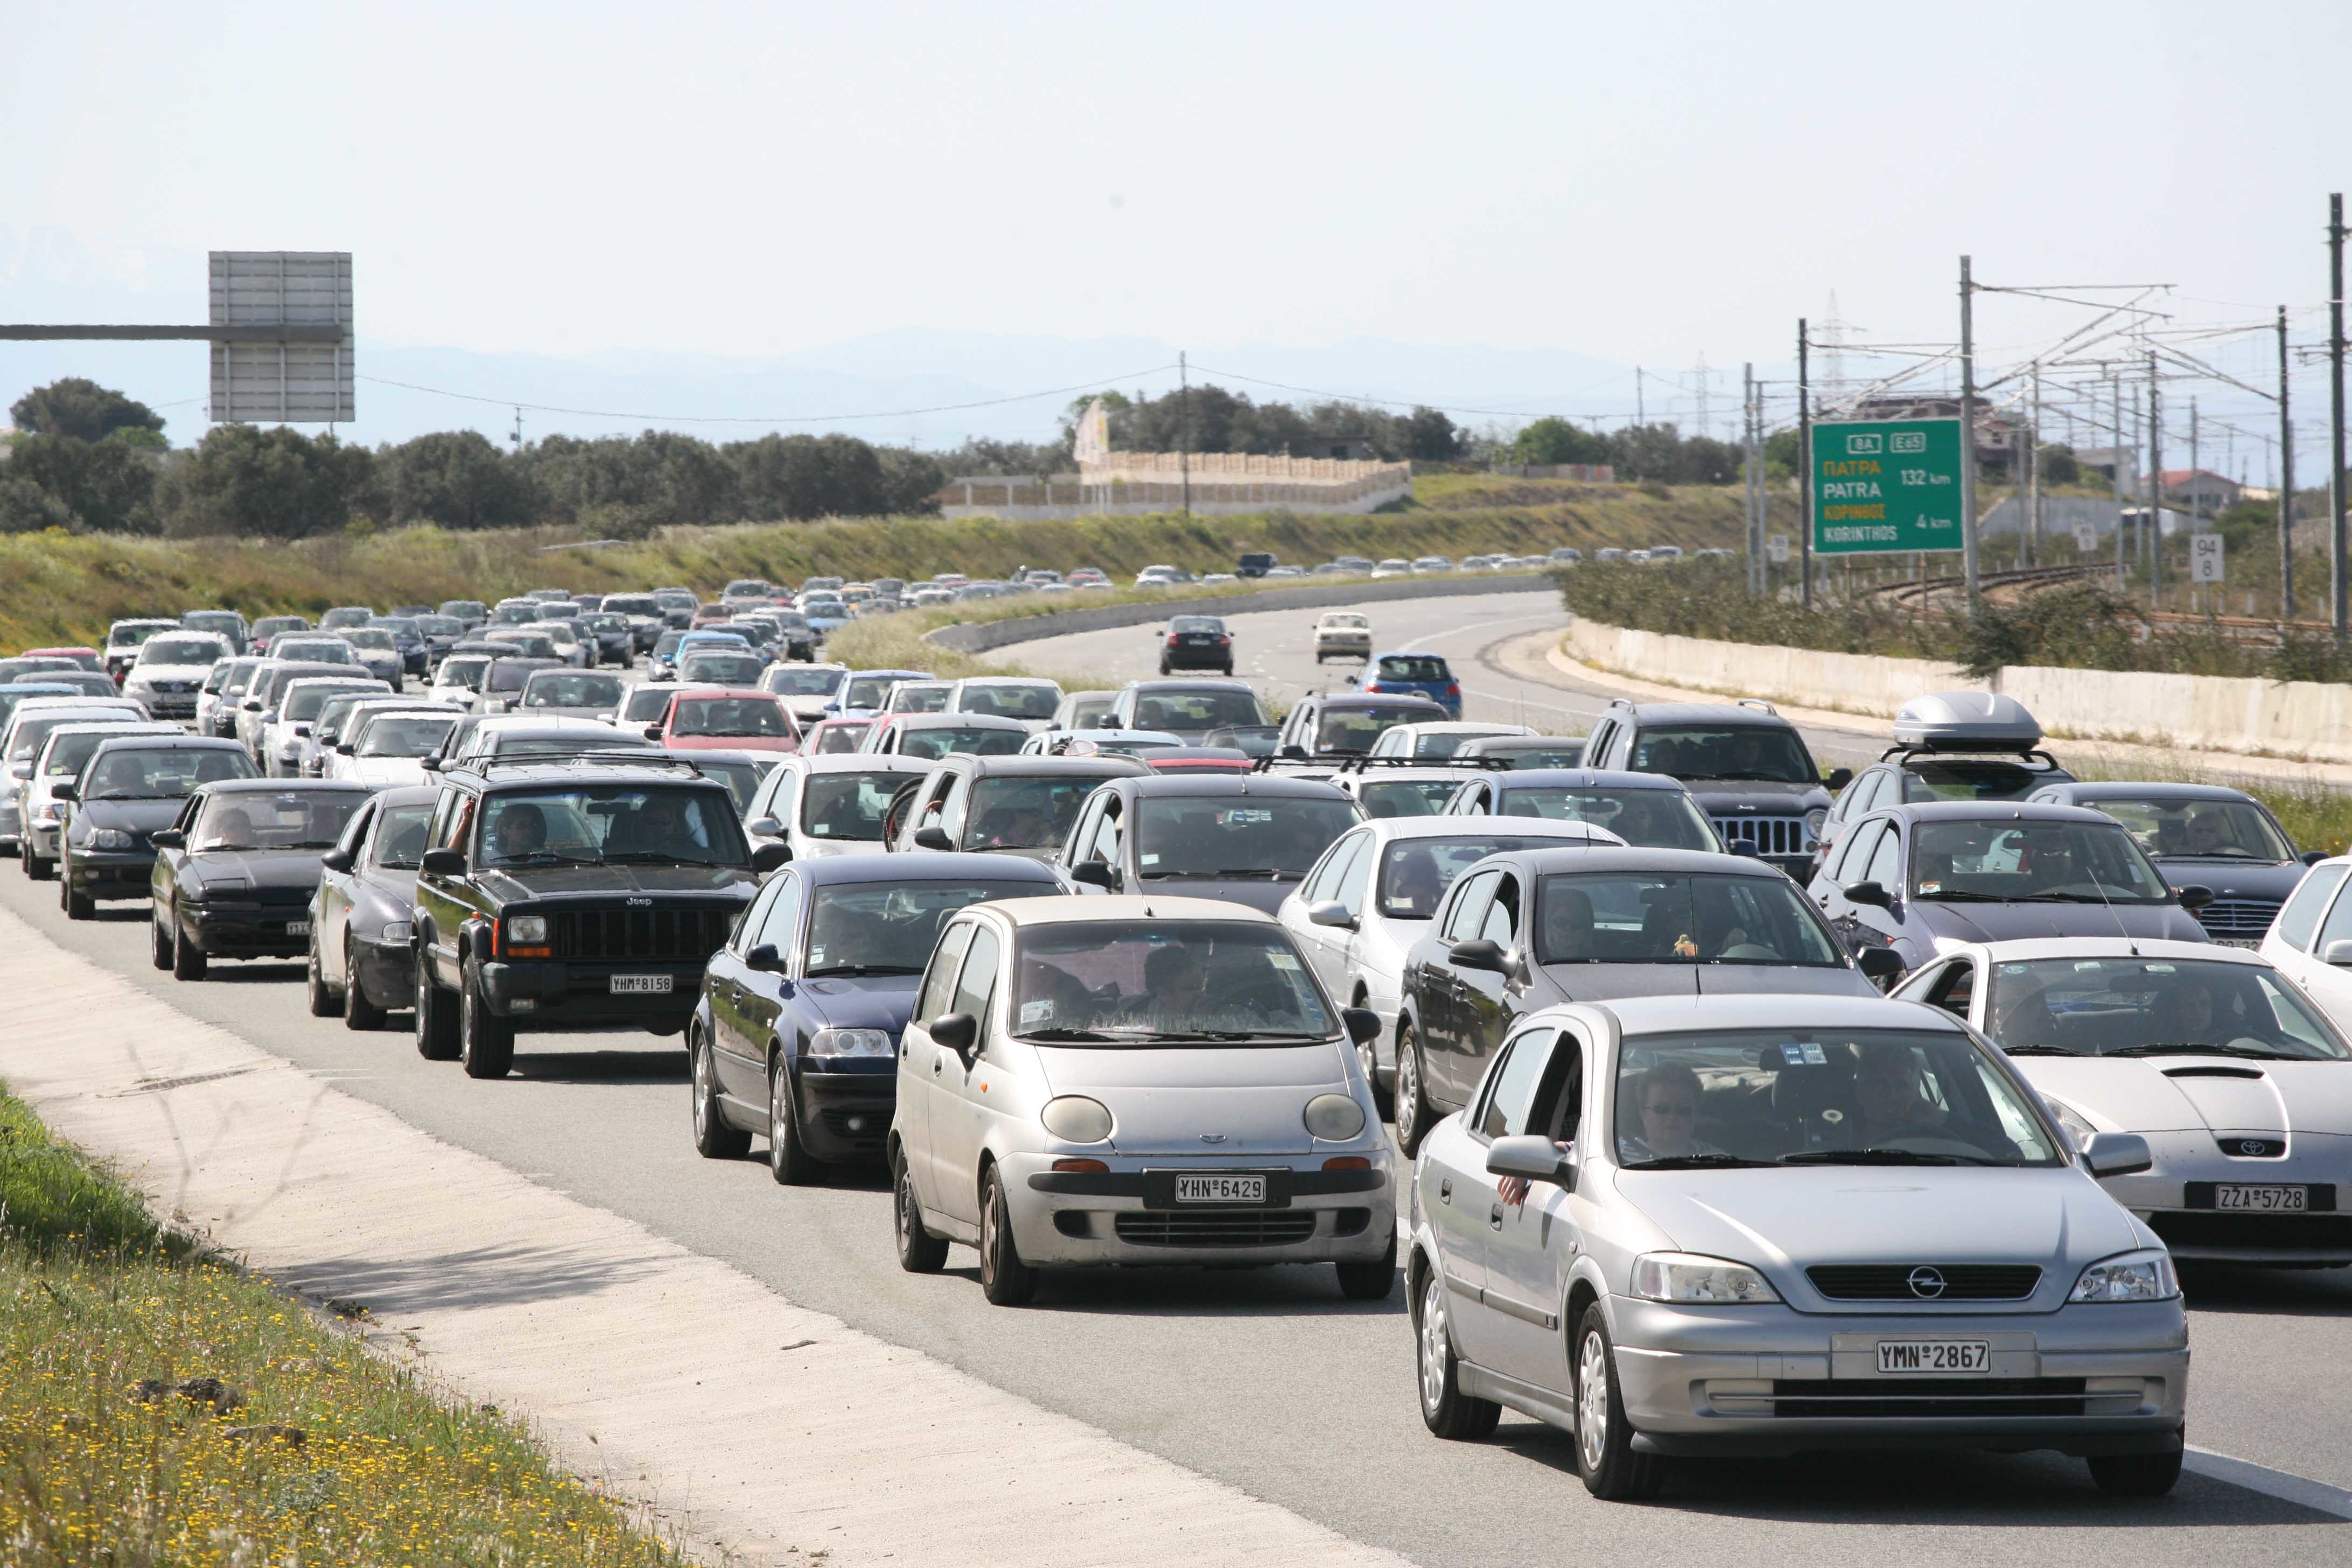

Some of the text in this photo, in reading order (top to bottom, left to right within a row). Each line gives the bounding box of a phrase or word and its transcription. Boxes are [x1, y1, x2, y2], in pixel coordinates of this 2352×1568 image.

[1823, 460, 1882, 477] ΠΑΤΡΑ
[1901, 470, 1951, 485] 132 km
[1823, 482, 1882, 499] PATRA
[1915, 514, 1952, 529] 4 km
[1824, 526, 1898, 543] KORINTHOS
[2197, 539, 2216, 556] 94
[2203, 560, 2213, 577] 8
[626, 897, 653, 906] Jeep
